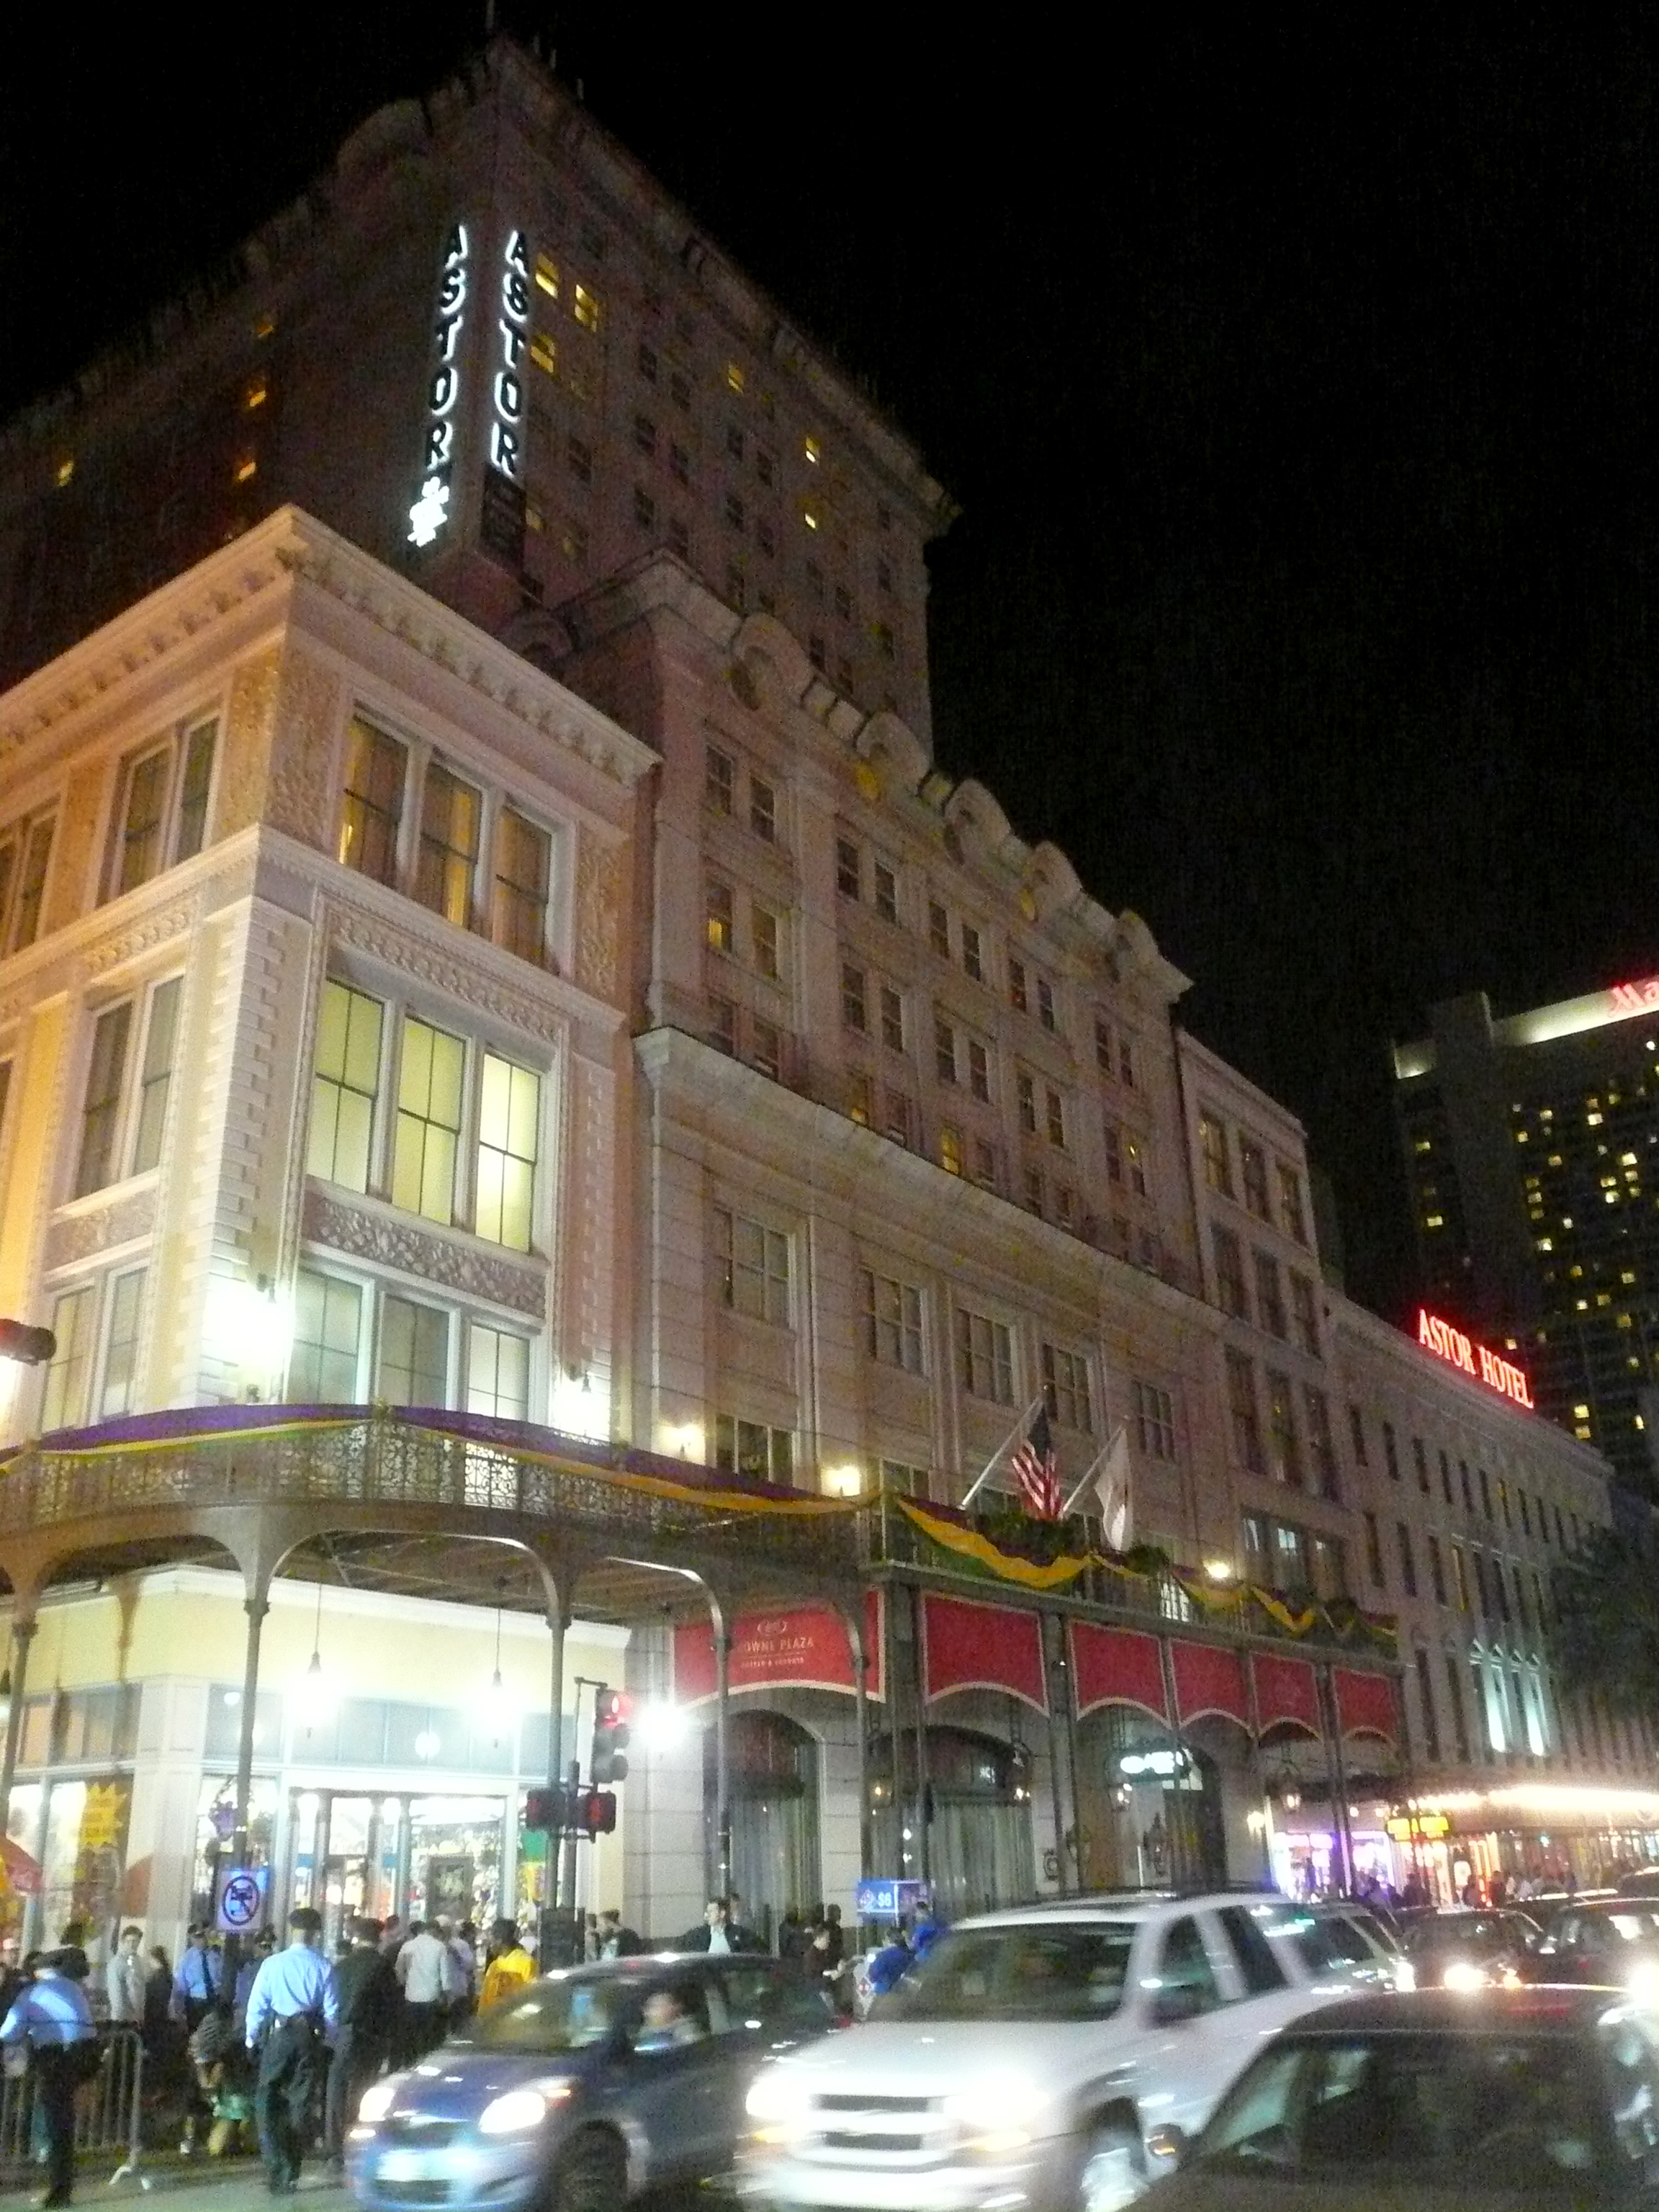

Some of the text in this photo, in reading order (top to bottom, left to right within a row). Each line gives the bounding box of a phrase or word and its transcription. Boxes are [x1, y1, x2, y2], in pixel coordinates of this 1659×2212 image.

[426, 224, 469, 472] ASTOR
[490, 229, 529, 478] ASTOR
[1419, 1309, 1534, 1408] ASTOR HOTEL
